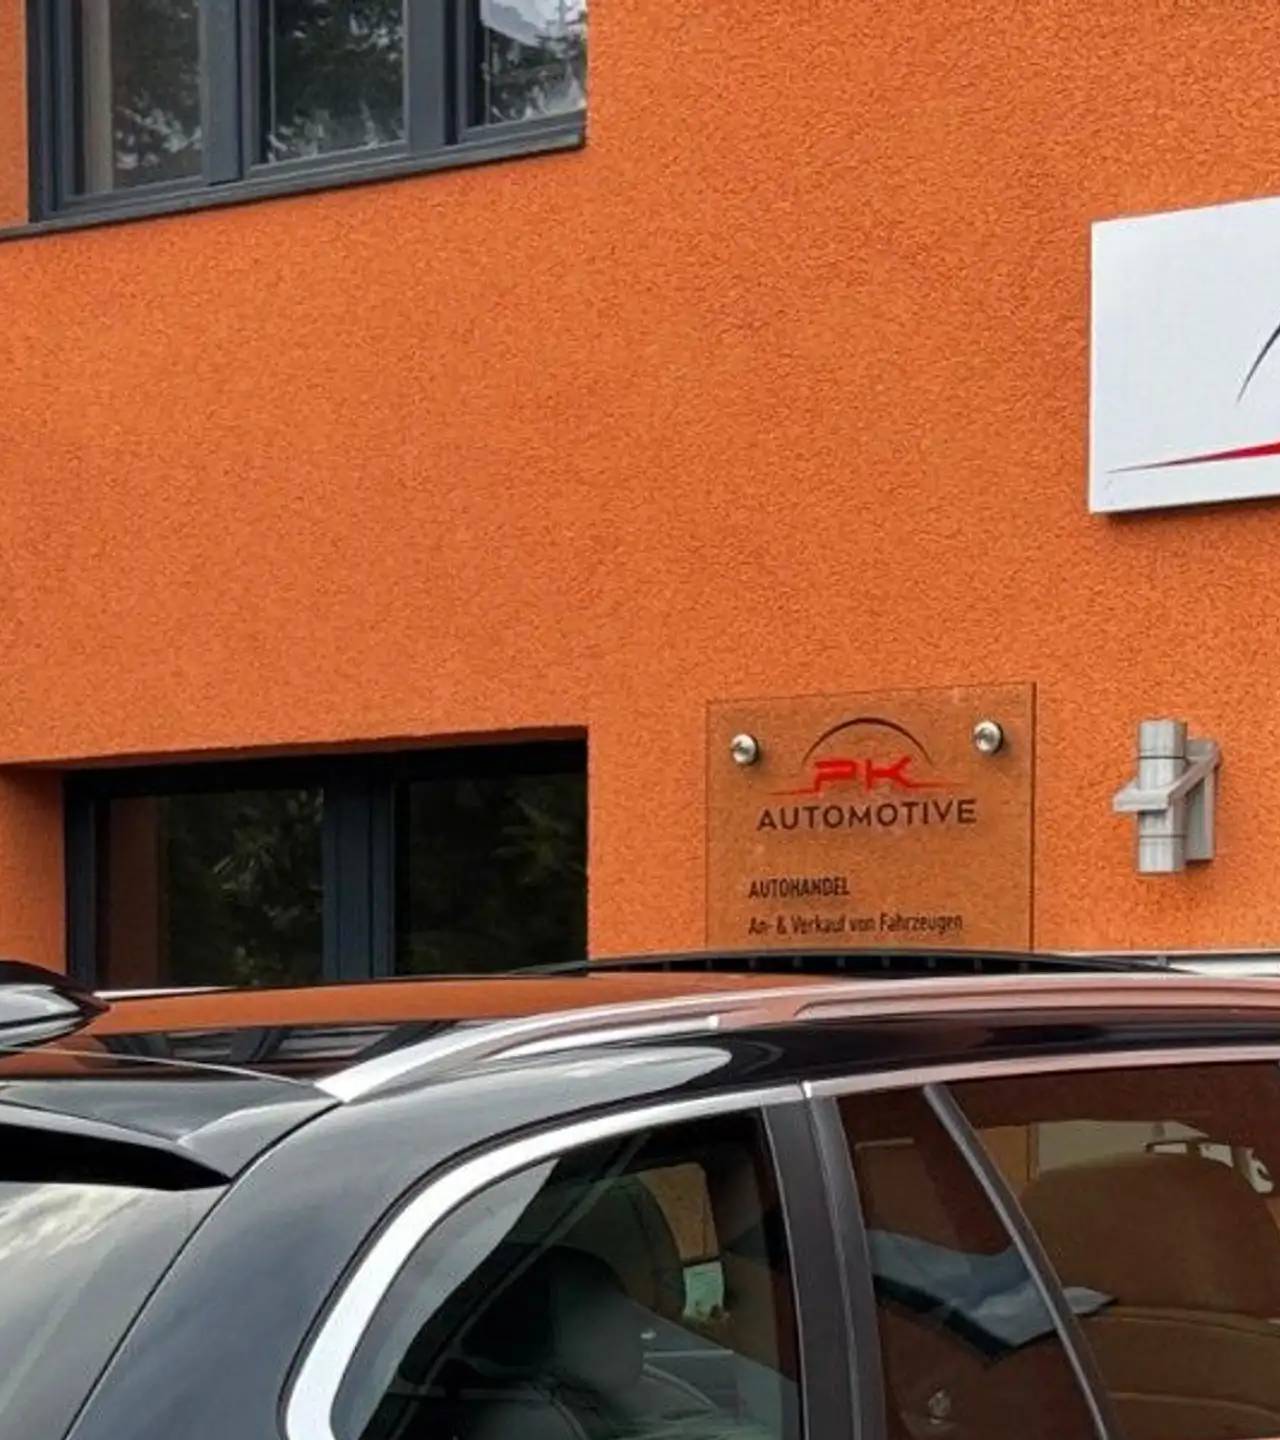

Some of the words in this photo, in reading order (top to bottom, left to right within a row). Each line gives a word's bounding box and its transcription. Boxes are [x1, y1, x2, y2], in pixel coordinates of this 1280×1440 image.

[814, 756, 912, 792] PK
[756, 799, 977, 832] AUTOMOTIVE
[748, 876, 851, 899] AUTOHANDEL
[791, 912, 845, 934] Verkauf
[851, 917, 875, 933] von
[879, 911, 964, 936] Fahrzeugen
